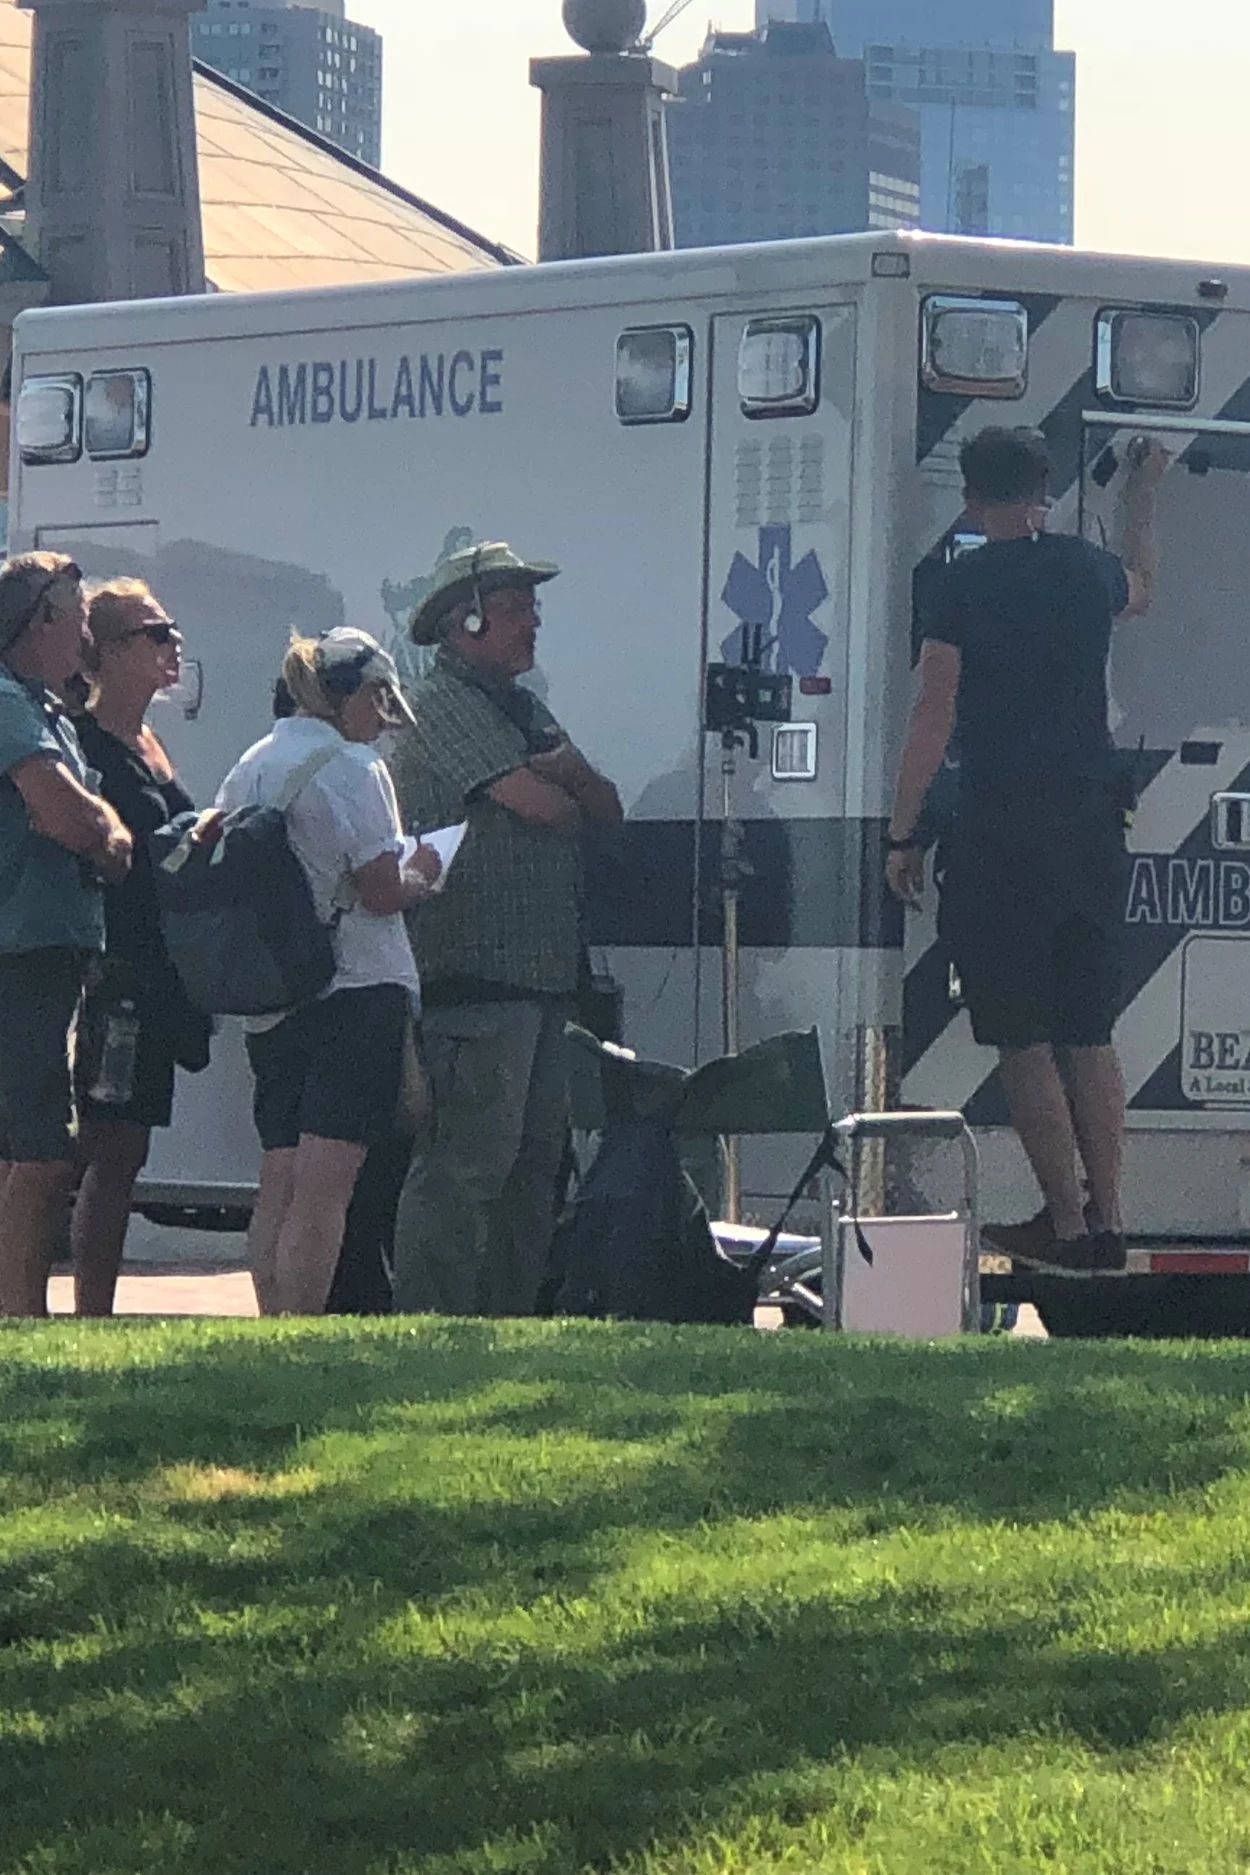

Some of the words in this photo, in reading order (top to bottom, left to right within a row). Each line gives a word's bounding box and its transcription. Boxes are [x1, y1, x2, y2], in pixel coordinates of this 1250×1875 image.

[250, 349, 503, 427] AMBULANCE
[1190, 1076, 1201, 1092] A
[1204, 1075, 1245, 1094] Local
